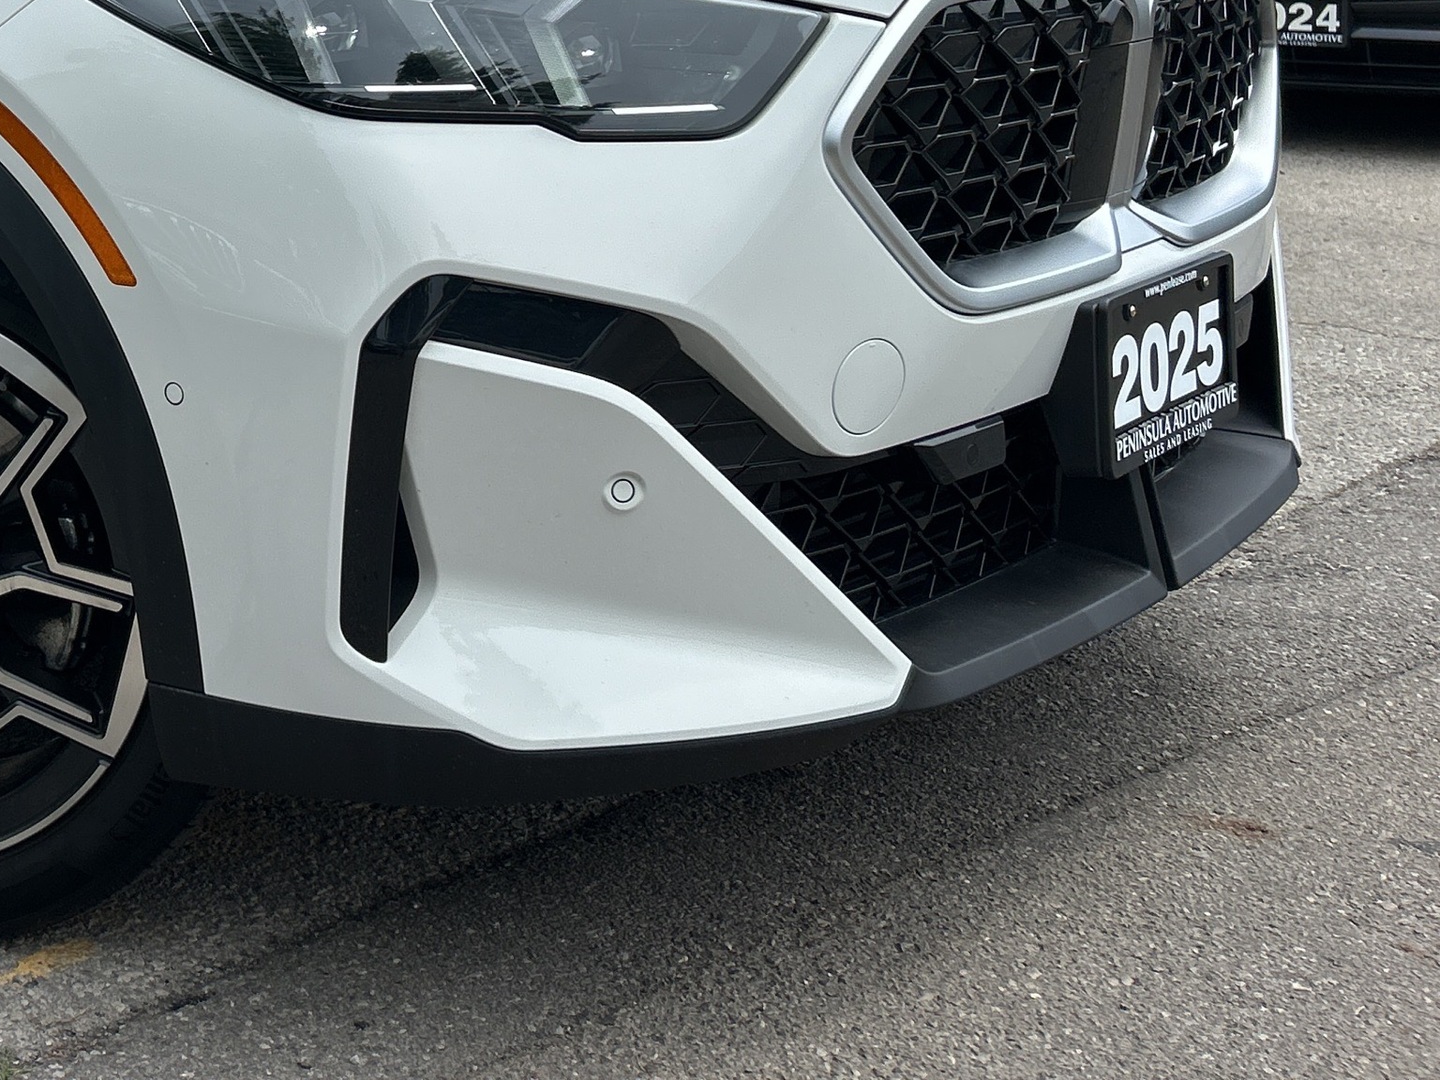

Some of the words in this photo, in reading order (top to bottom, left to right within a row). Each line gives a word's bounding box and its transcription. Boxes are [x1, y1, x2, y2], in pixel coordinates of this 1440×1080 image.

[1275, 1, 1340, 33] 24
[1280, 32, 1343, 44] AUTOMOTIVE
[1111, 298, 1224, 430] 2025
[1116, 415, 1173, 462] PENINSULA
[1172, 383, 1238, 432] AUTOMOTIVE
[1144, 442, 1165, 463] SALES
[1166, 433, 1182, 451] AND
[1183, 418, 1213, 442] LEASING
